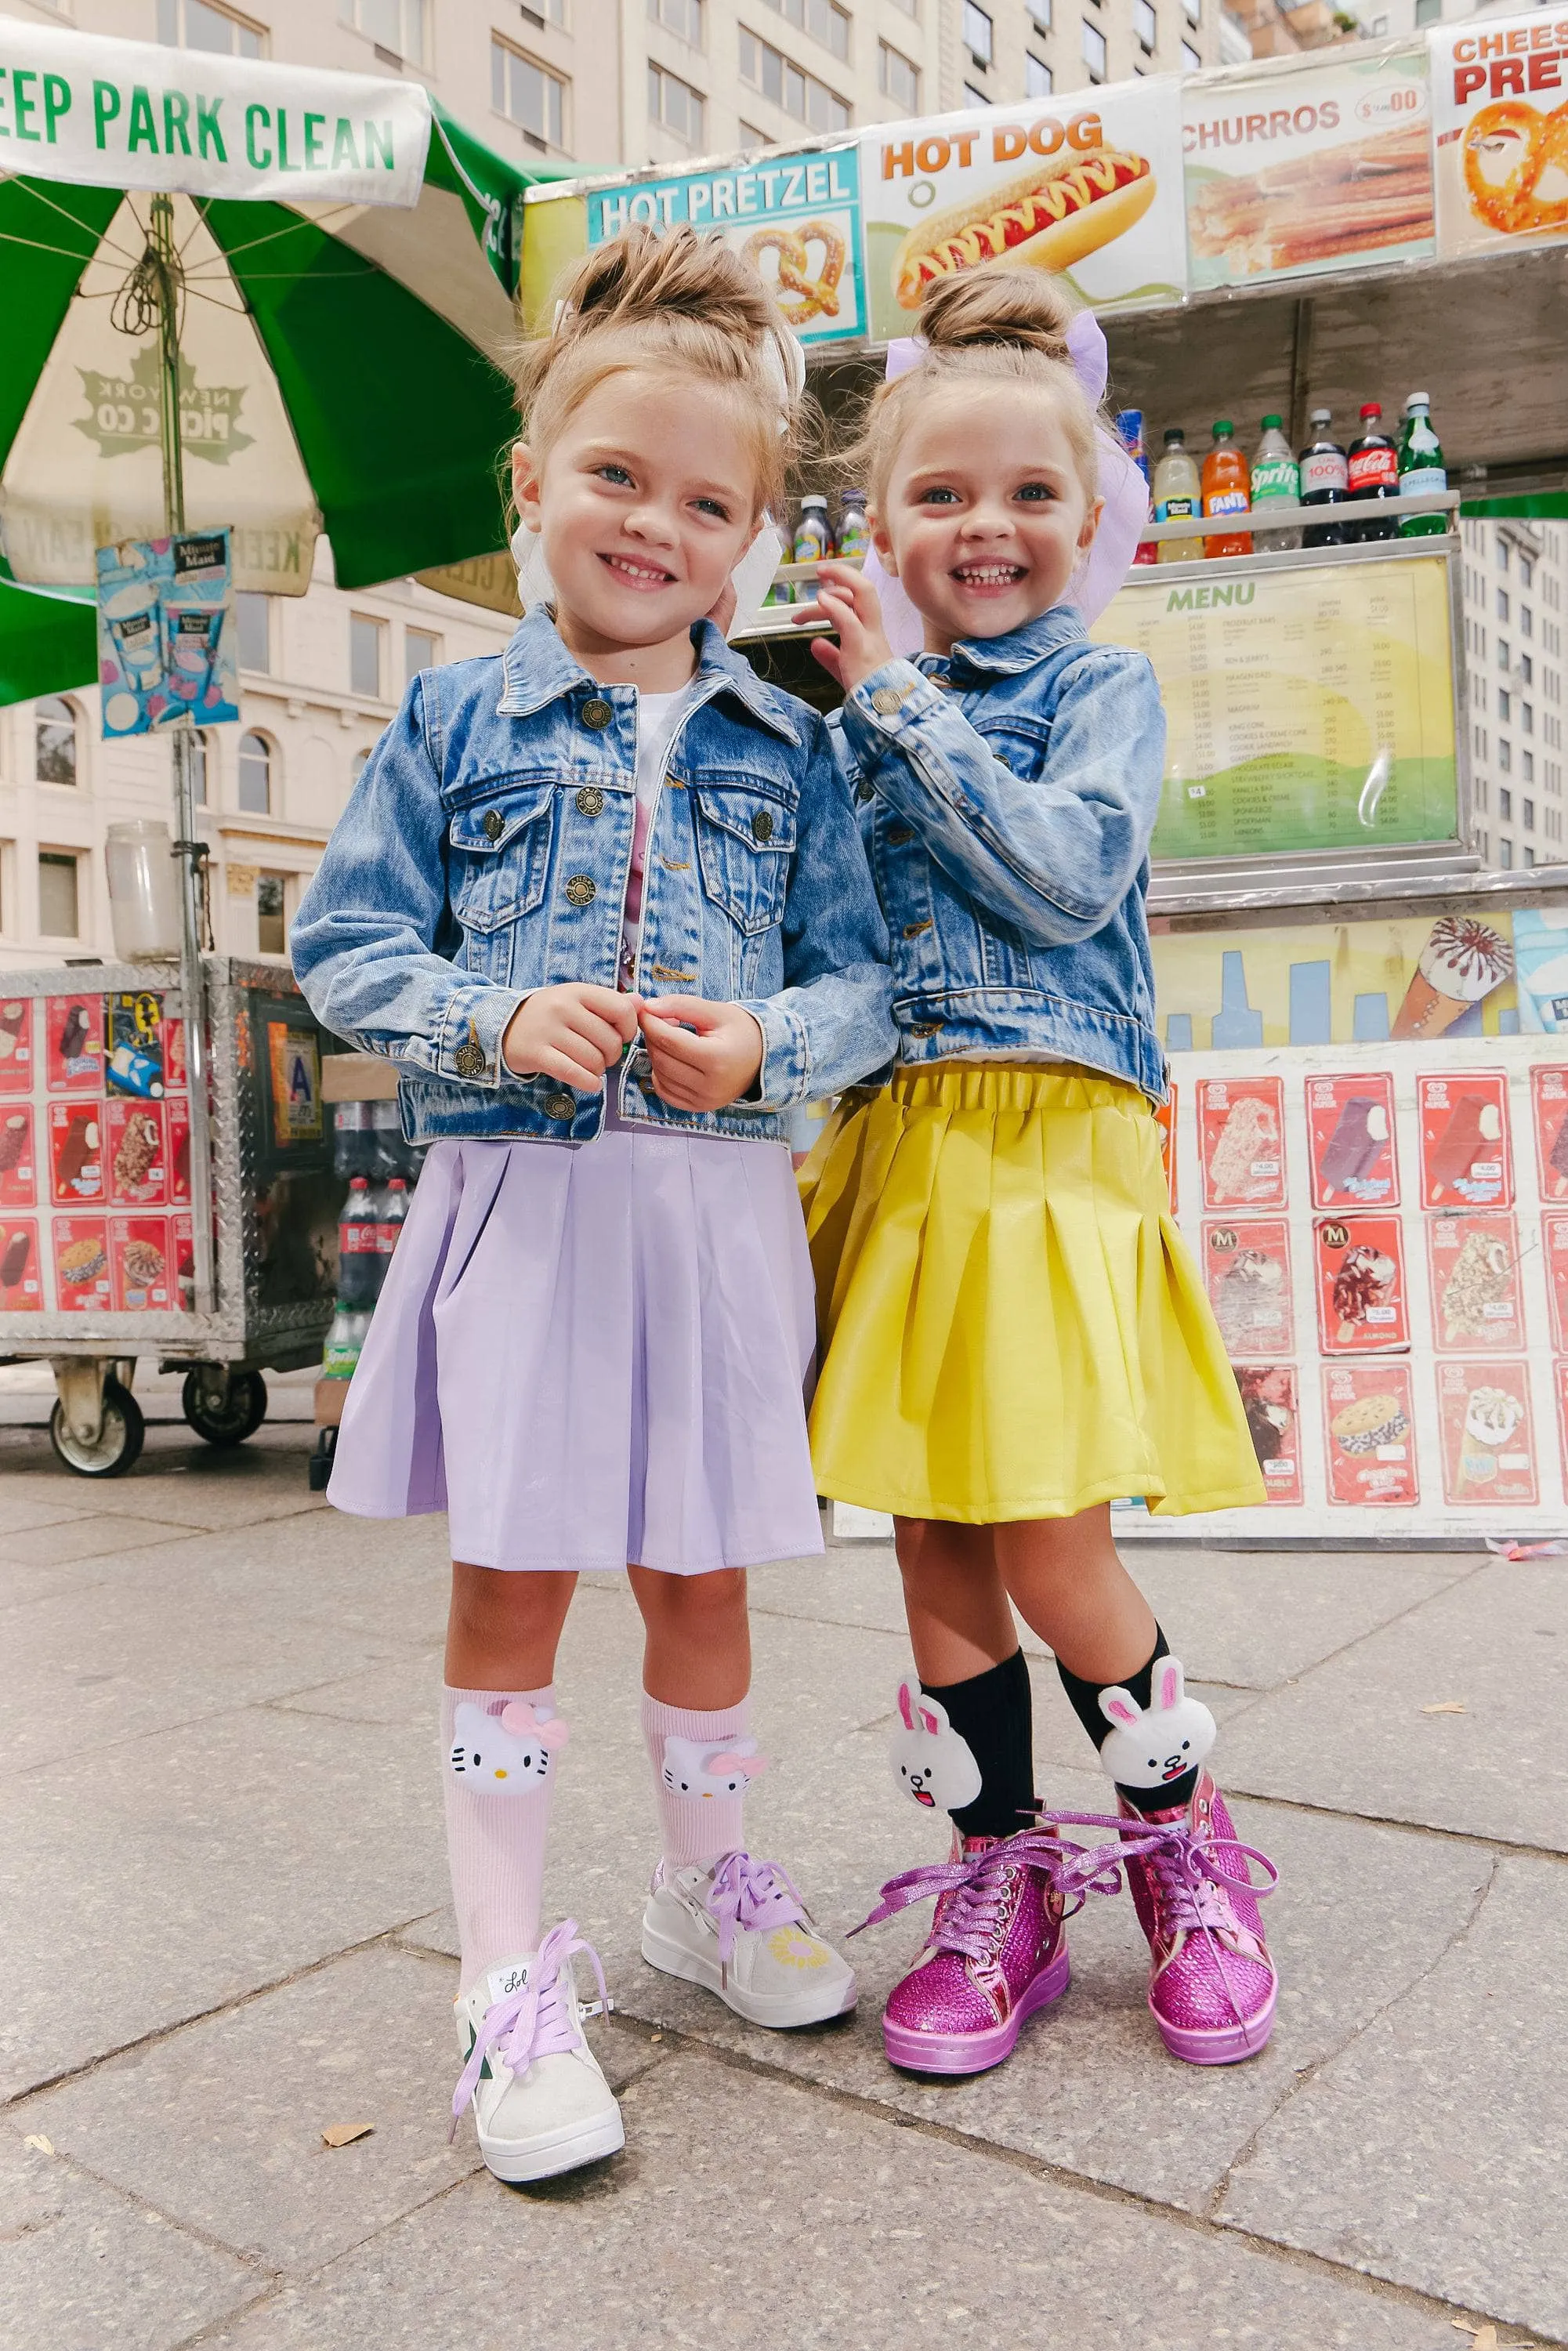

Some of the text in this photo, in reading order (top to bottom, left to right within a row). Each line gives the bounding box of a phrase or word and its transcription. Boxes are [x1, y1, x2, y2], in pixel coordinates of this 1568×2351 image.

[1454, 49, 1568, 106] PRE
[93, 80, 227, 163] PARK
[244, 103, 395, 172] CLEAN
[882, 112, 1103, 180] HOT DOG
[1181, 100, 1341, 153] CHURROS
[601, 161, 850, 236] HOT PRETZEL
[179, 542, 219, 556] Minute
[186, 553, 215, 567] Maid
[1167, 582, 1255, 612] MENU
[291, 1056, 311, 1101] A
[1217, 1231, 1233, 1246] M
[1327, 1226, 1345, 1243] M
